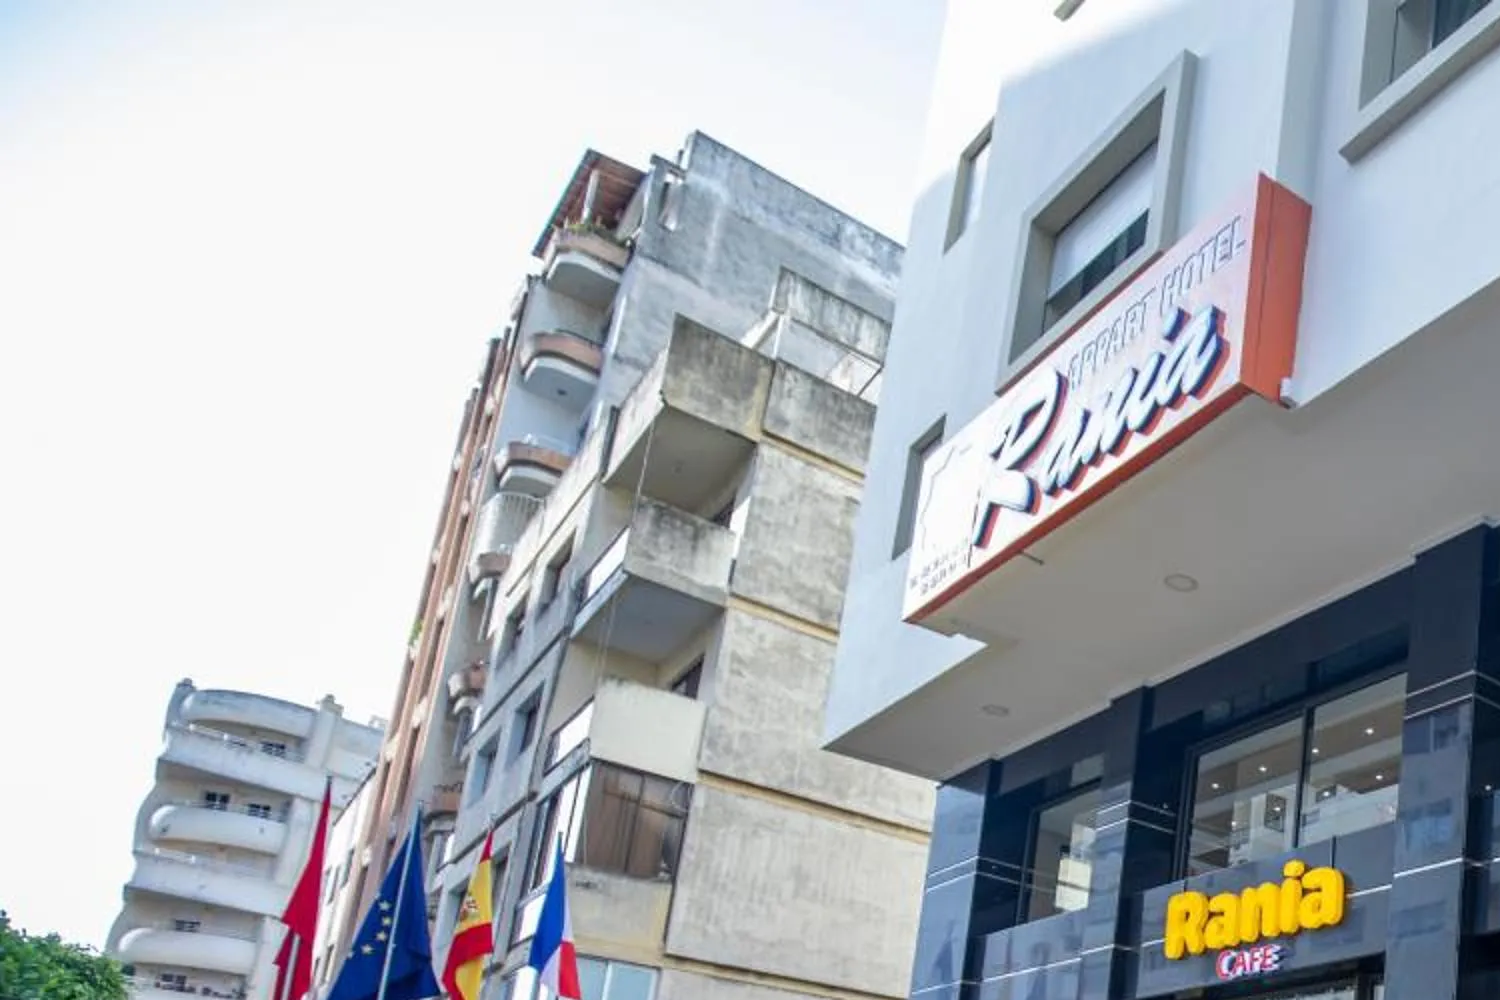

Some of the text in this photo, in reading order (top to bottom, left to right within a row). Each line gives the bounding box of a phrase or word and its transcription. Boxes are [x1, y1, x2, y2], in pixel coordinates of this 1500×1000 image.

[1160, 215, 1248, 318] HOTEL
[971, 303, 1232, 550] Rania
[1164, 858, 1346, 960] Rania
[1216, 944, 1284, 981] CAFE
